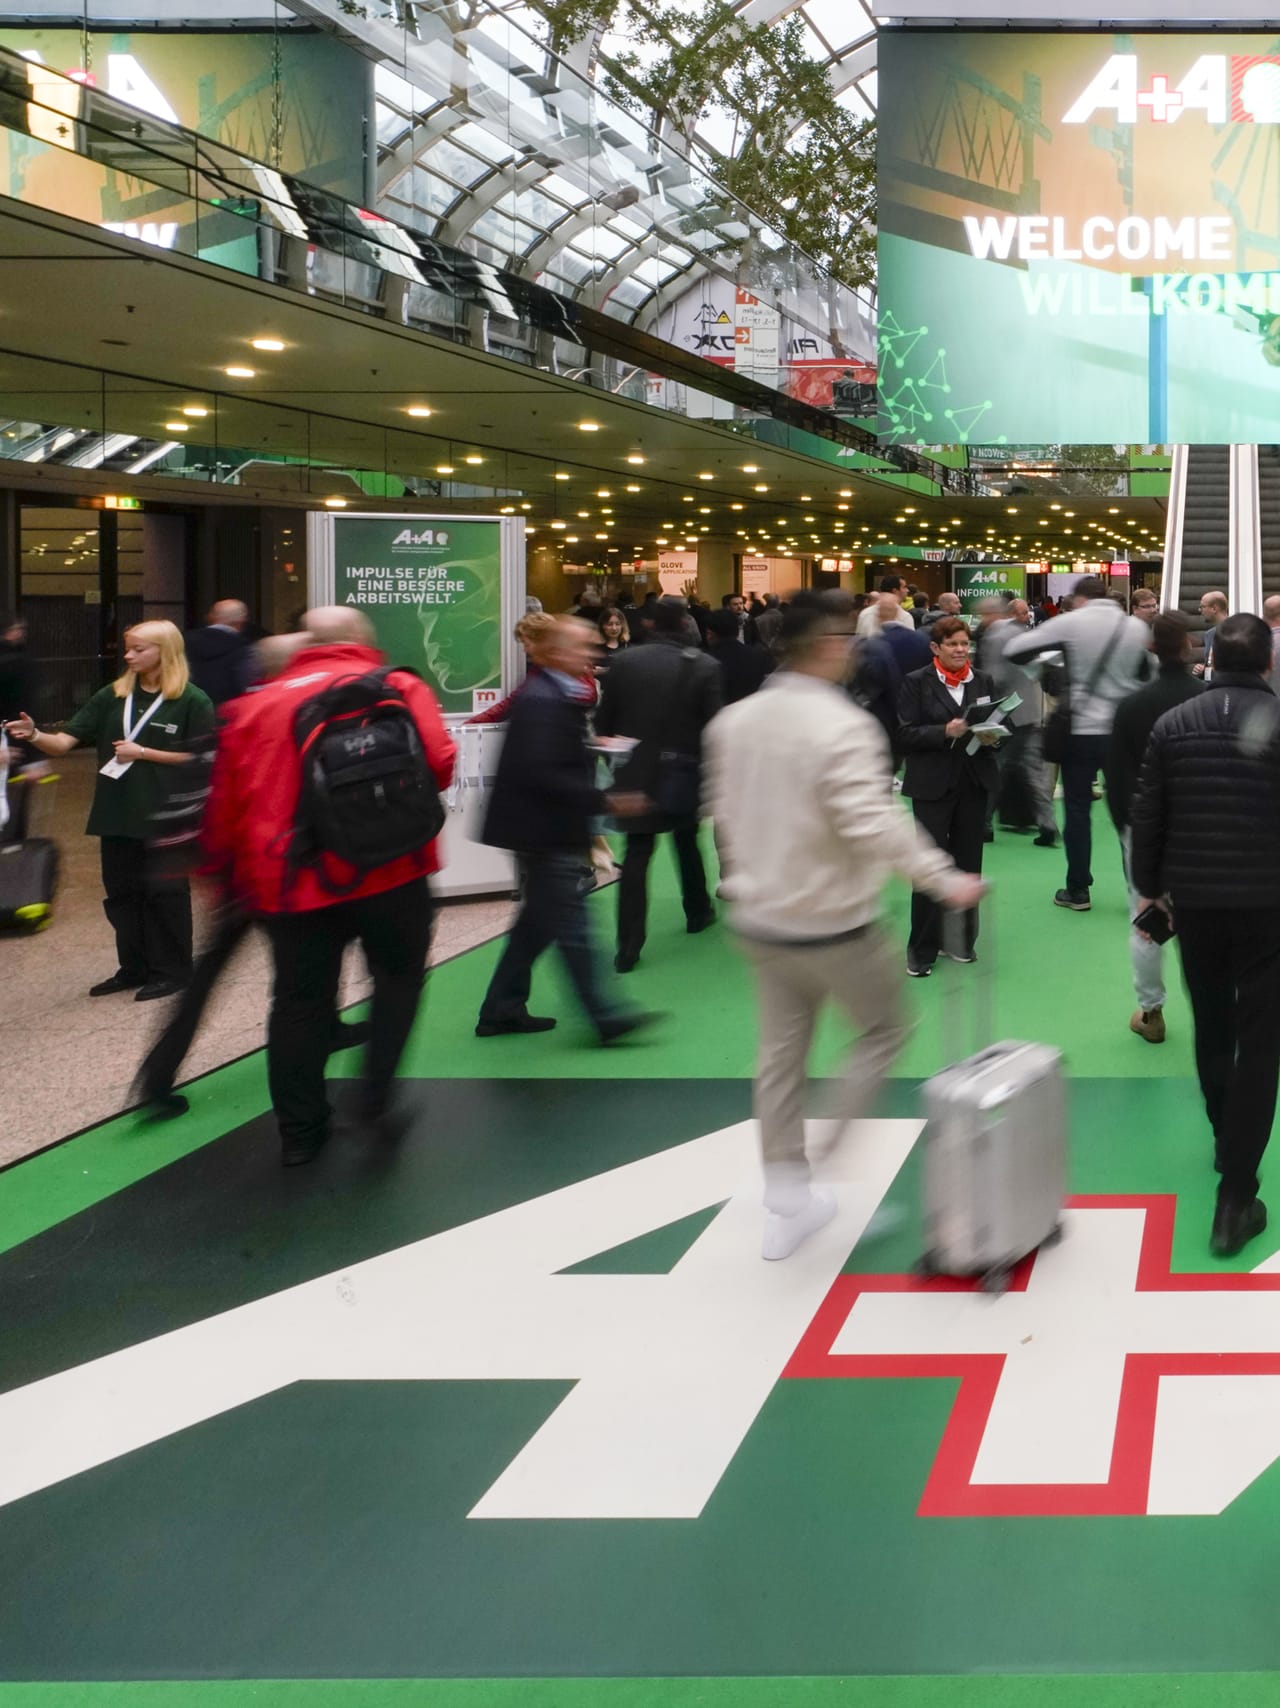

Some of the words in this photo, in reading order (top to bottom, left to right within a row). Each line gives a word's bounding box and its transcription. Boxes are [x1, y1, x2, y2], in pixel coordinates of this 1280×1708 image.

[1060, 53, 1228, 124] A+A
[963, 215, 1232, 260] WELCOME
[391, 529, 433, 545] A+A
[346, 567, 414, 579] IMPULSE
[417, 565, 448, 579] FÜR
[357, 580, 394, 592] EINE
[397, 580, 465, 592] BESSERE
[345, 592, 456, 604] ARBEITSWELT.
